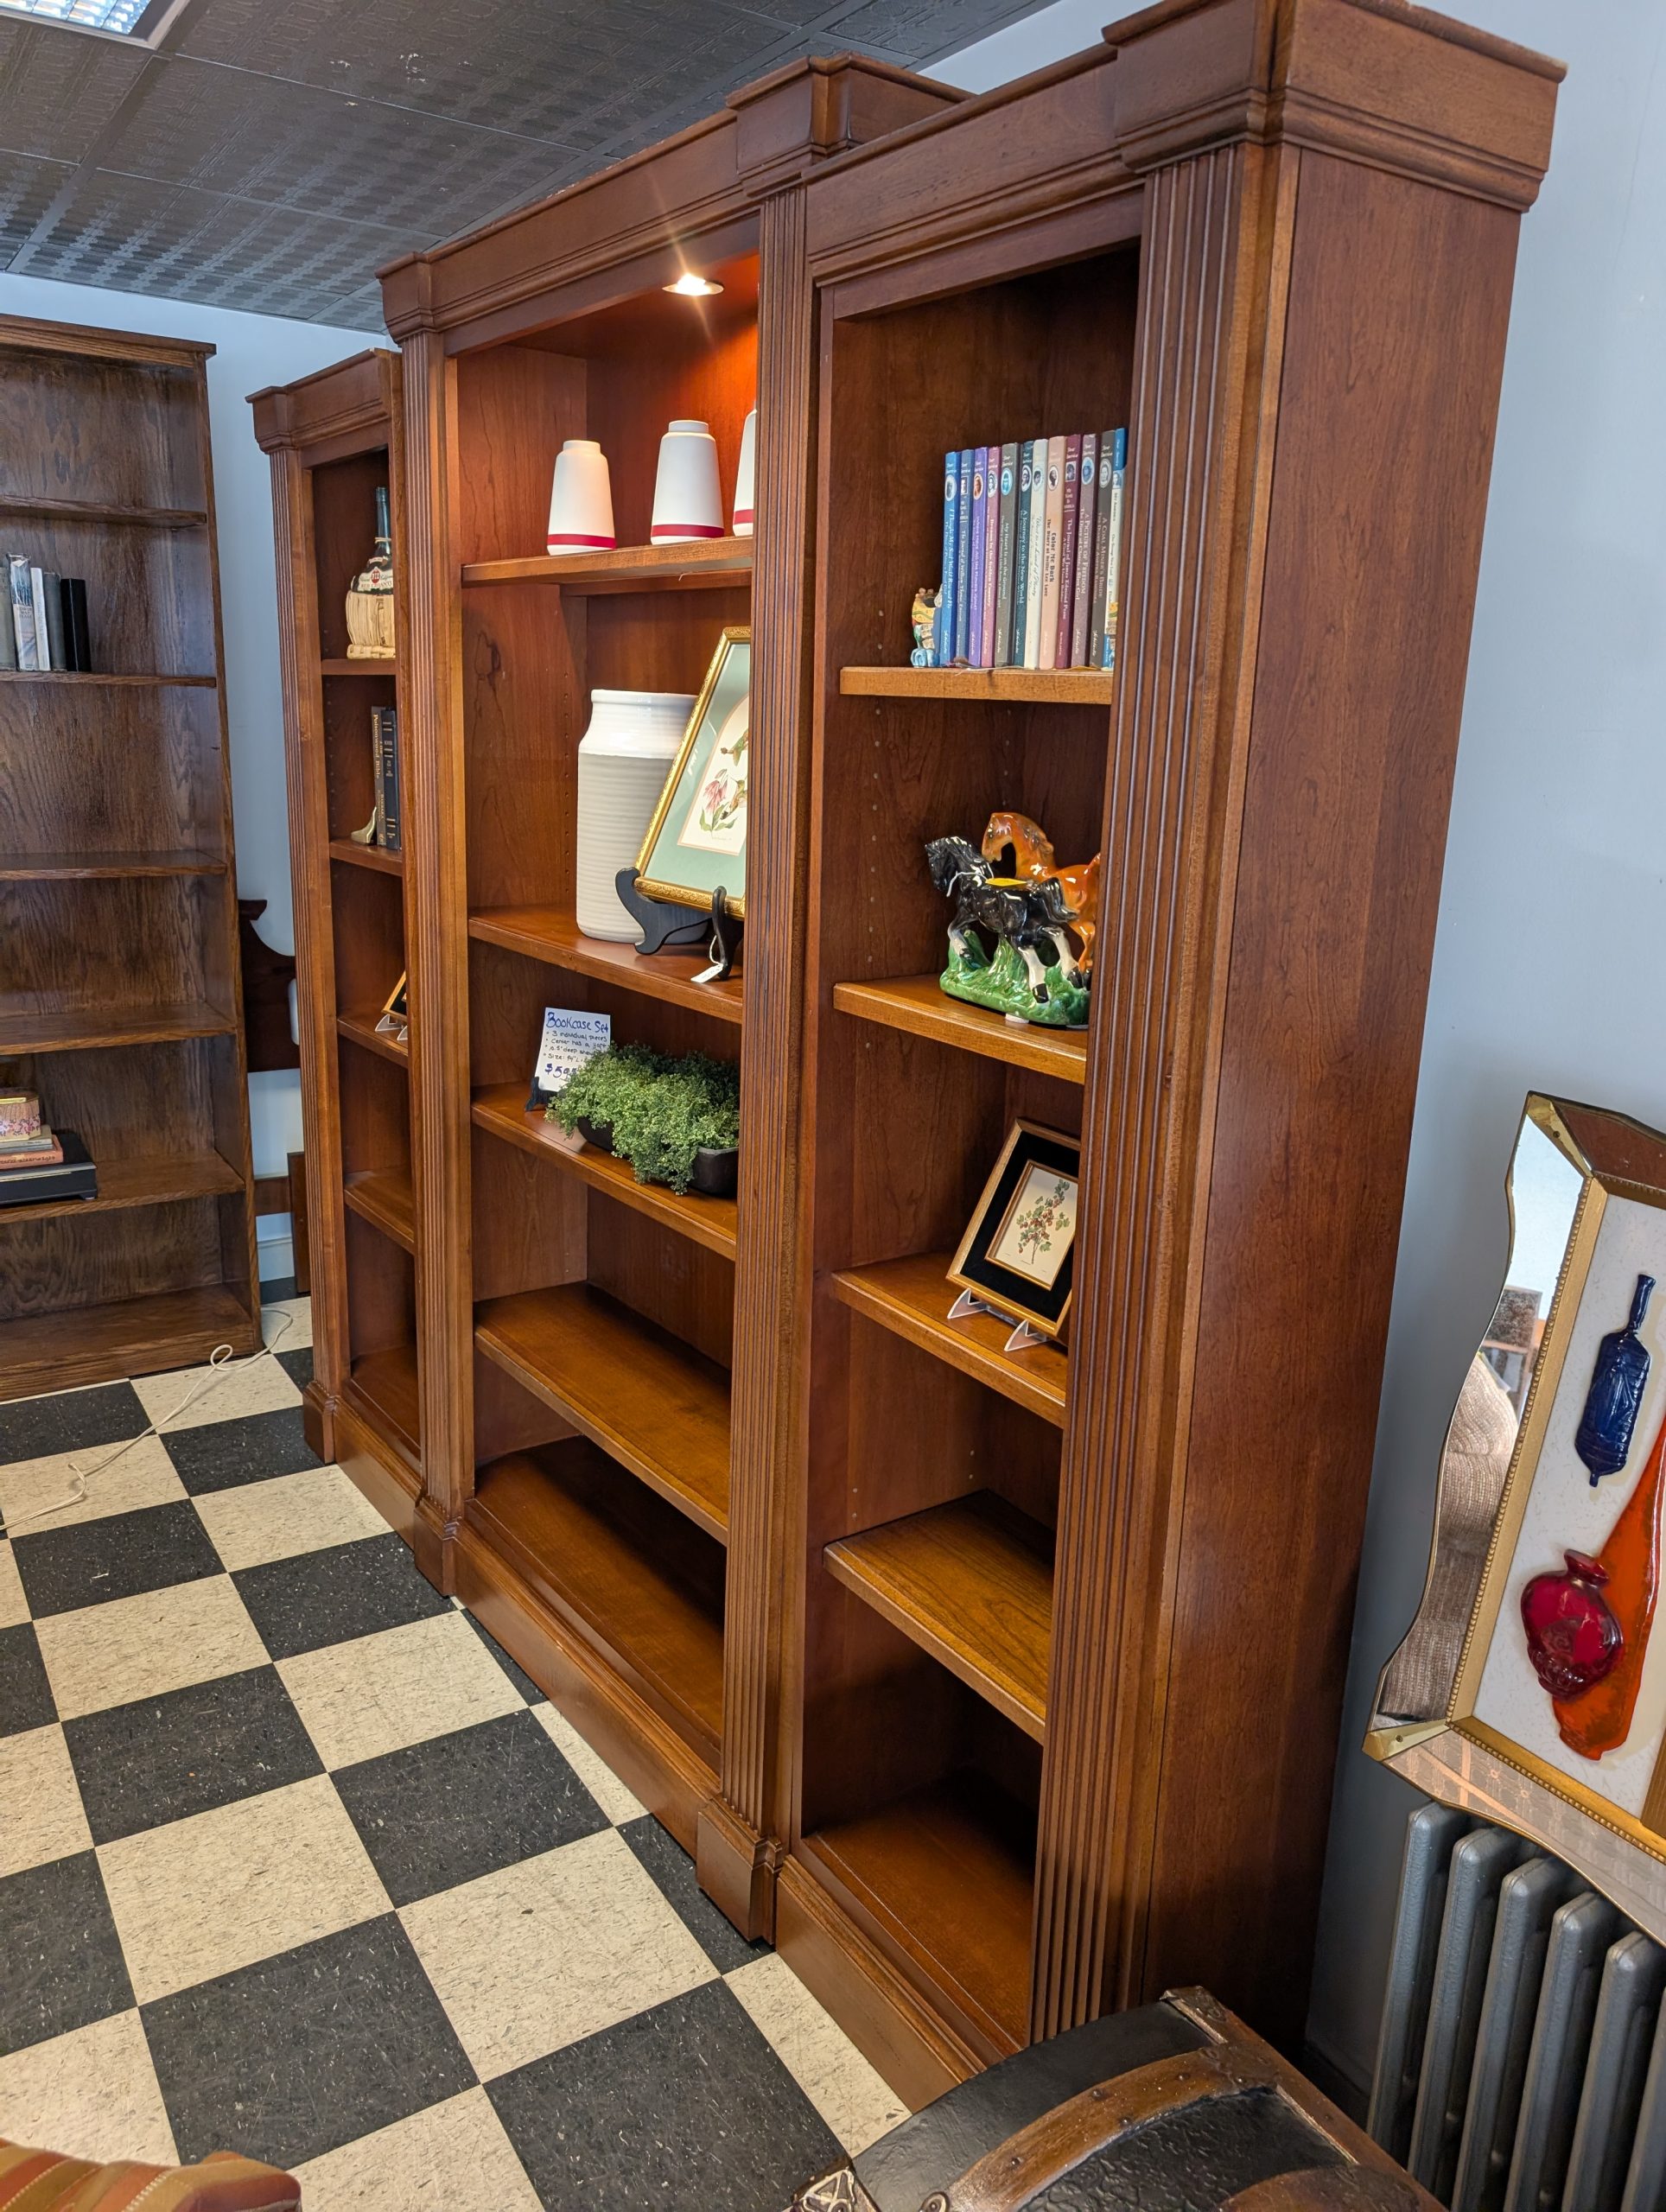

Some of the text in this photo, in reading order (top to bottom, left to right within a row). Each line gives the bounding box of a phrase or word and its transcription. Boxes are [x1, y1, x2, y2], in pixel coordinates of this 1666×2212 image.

[1004, 524, 1009, 532] My
[1020, 518, 1028, 543] Journey
[1082, 520, 1091, 548] PICTURE
[948, 536, 954, 545] My
[1050, 554, 1055, 563] Me
[595, 1020, 608, 1033] Set
